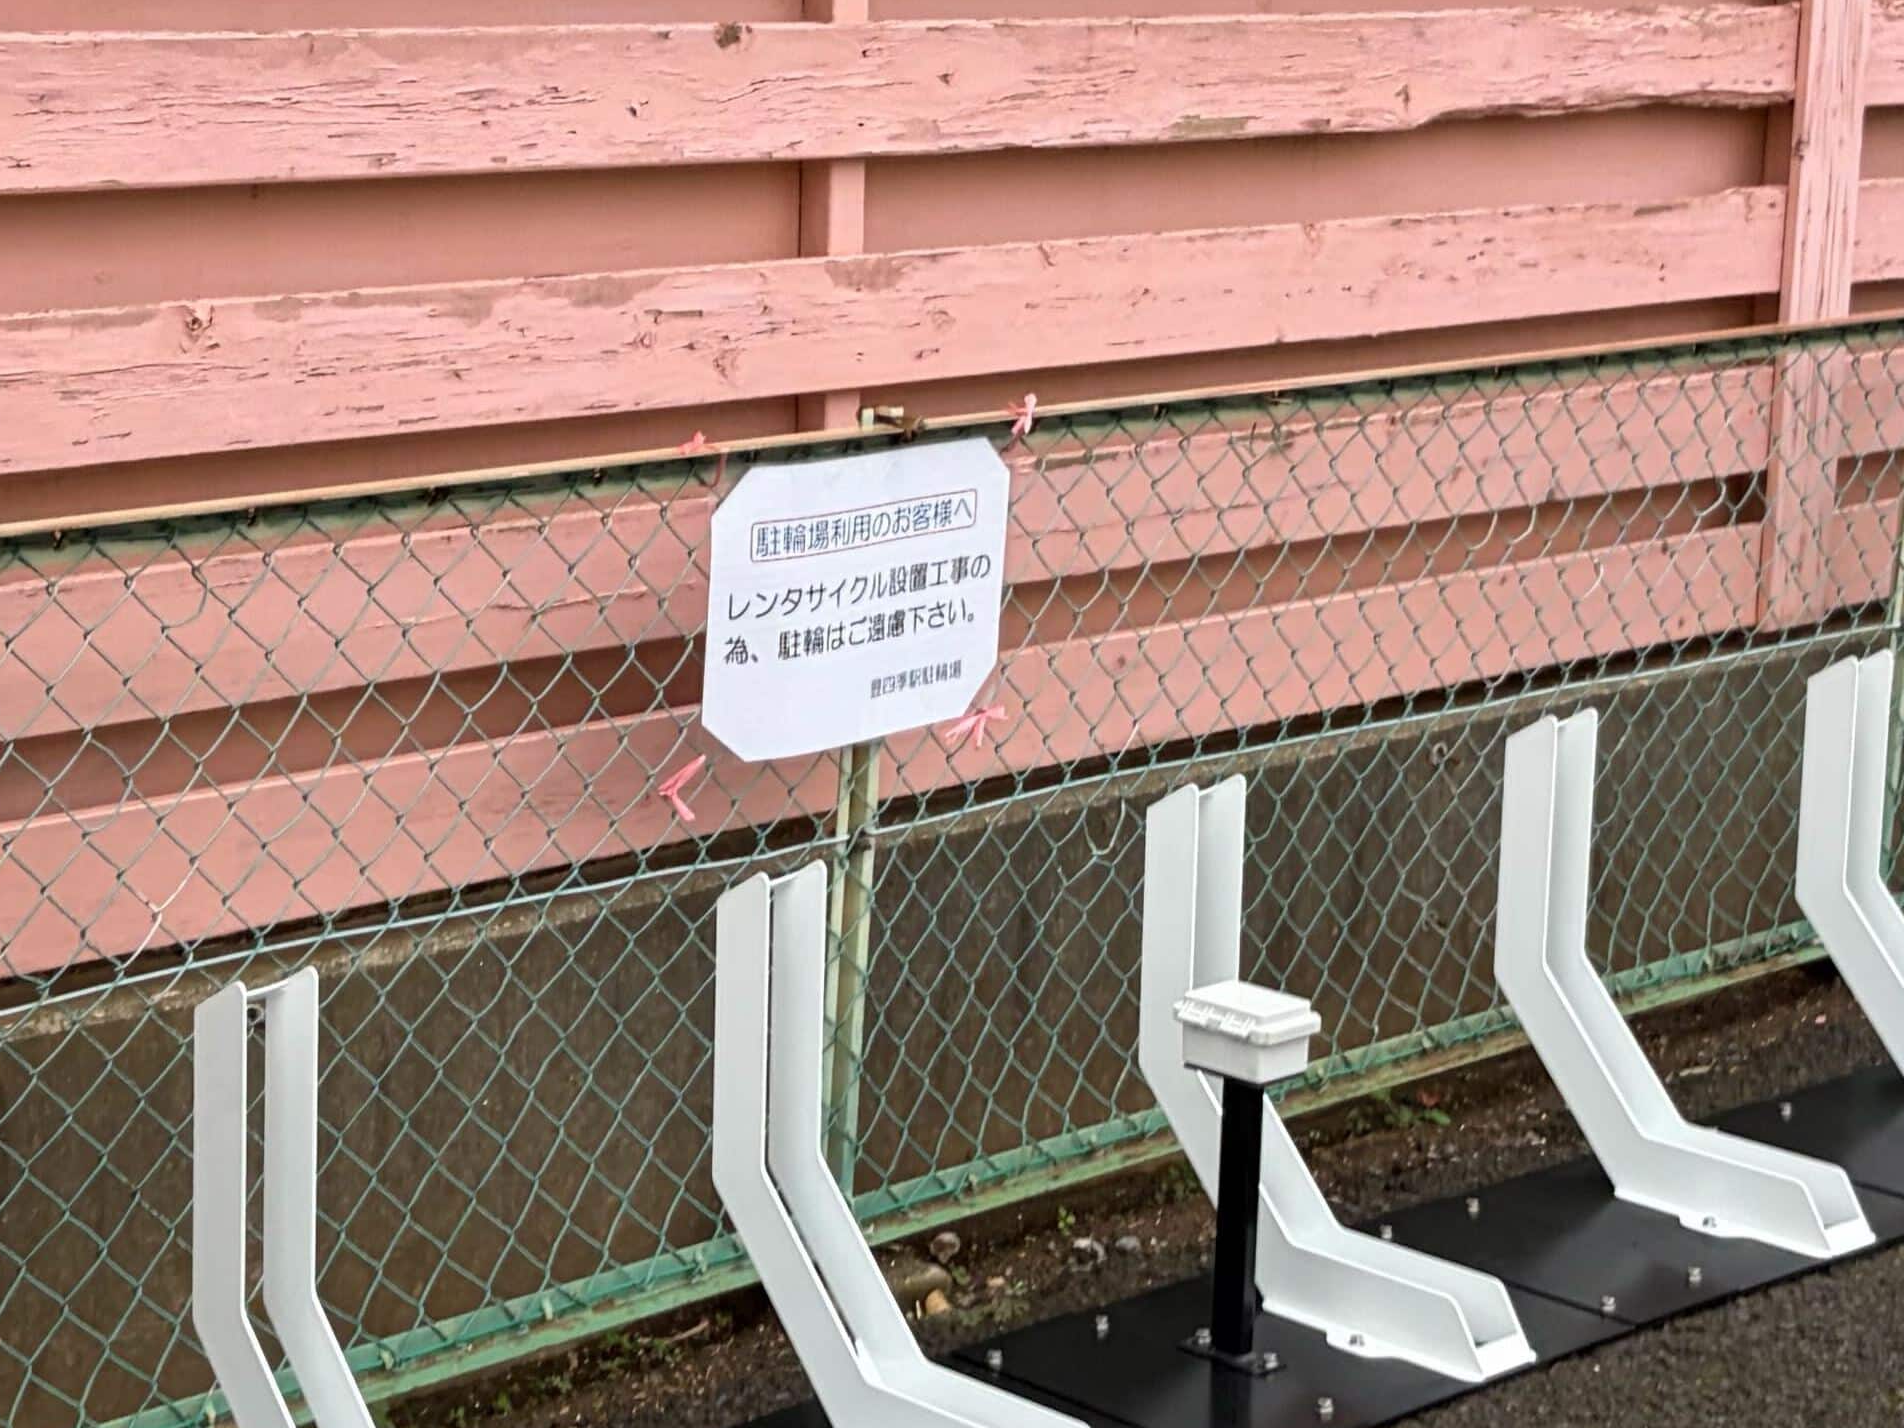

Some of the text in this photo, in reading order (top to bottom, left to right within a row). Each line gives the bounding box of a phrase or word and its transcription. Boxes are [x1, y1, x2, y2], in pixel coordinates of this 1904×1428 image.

[755, 497, 974, 558] 駐輪場利用のお客様へ
[728, 553, 991, 622] レンタサイクル設置工事の
